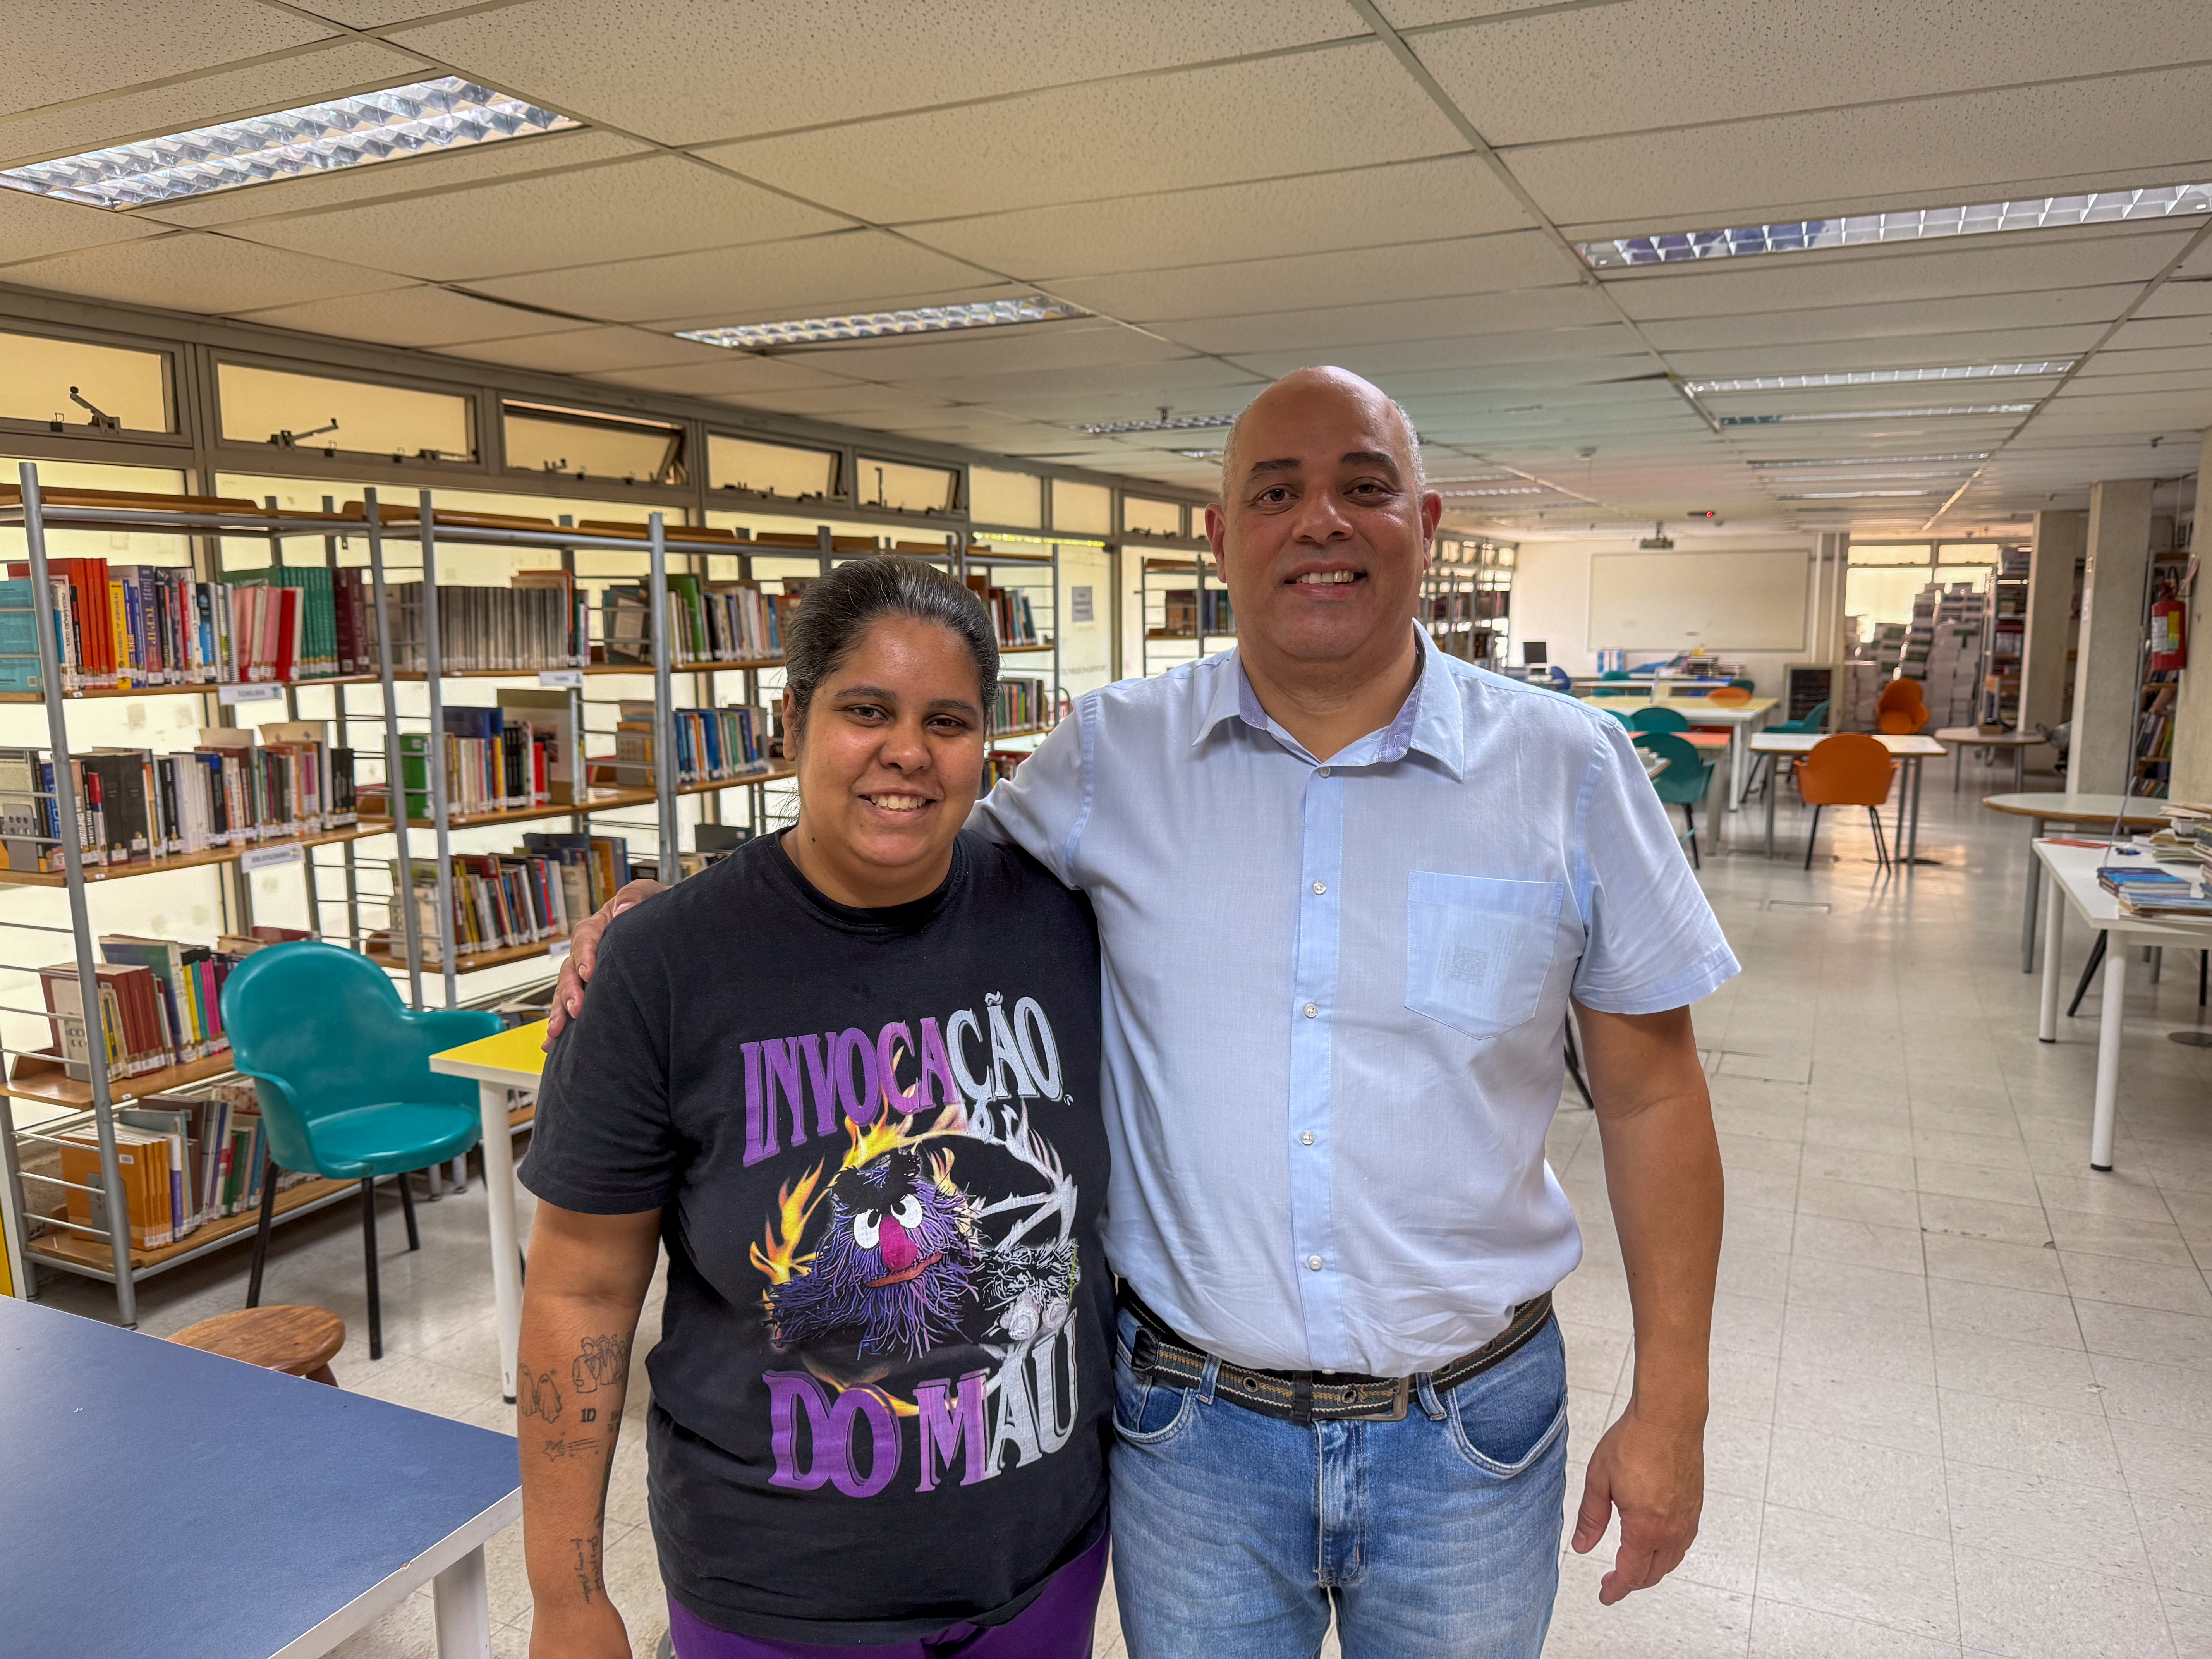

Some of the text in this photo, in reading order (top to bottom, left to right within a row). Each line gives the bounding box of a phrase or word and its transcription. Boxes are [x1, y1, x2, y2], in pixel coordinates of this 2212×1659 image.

[145, 605, 157, 645] TCP/IP
[740, 990, 1064, 1167] INVOCAÇÃO
[762, 1308, 1079, 1498] DO MAU
